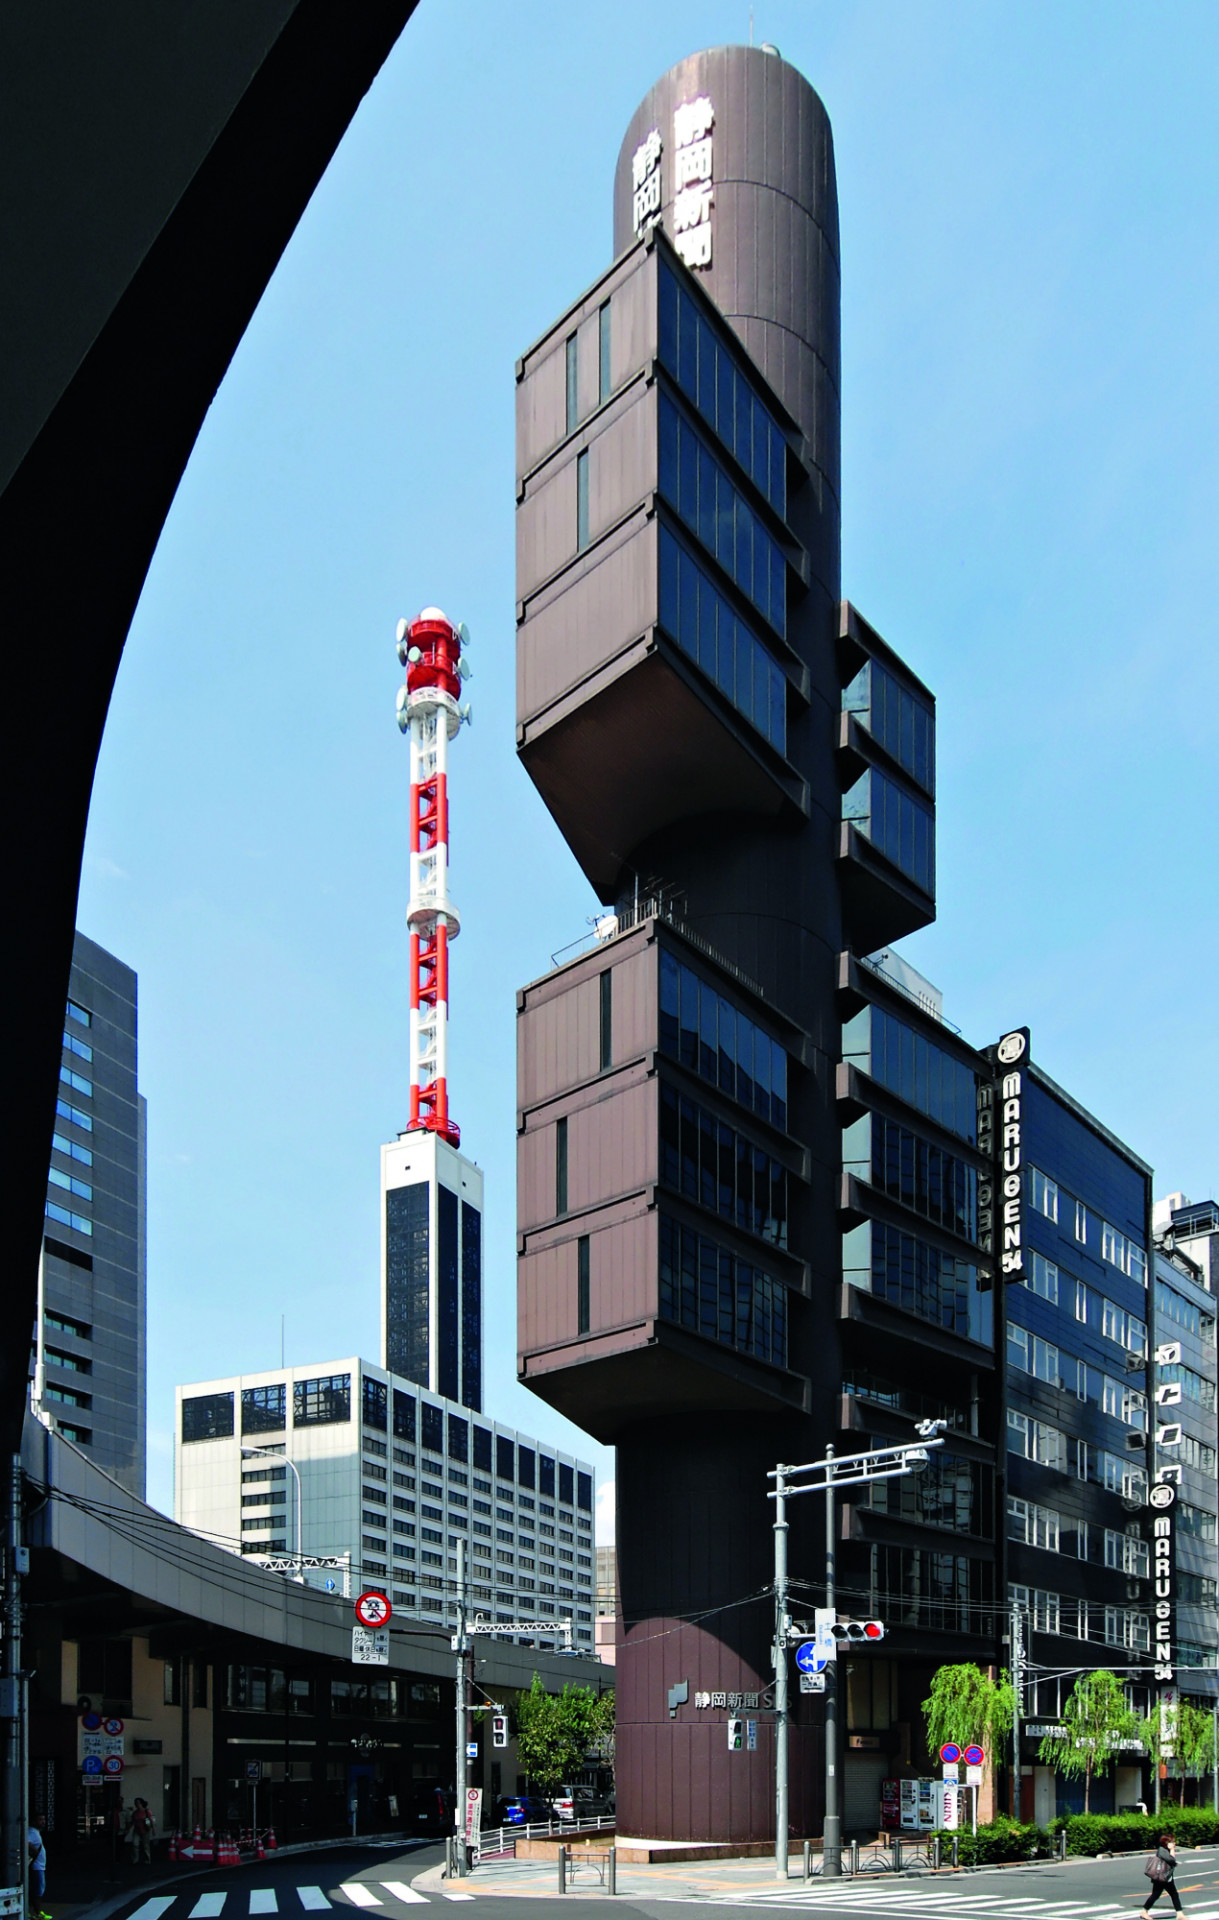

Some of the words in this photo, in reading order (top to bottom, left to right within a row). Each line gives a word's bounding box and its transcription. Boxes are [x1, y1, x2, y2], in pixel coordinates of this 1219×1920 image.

[632, 128, 663, 239] 静岡
[1002, 1071, 1022, 1249] MARUGEN
[1002, 1250, 1023, 1274] 54
[1154, 1516, 1172, 1662] MARUGEN
[1153, 1663, 1174, 1681] 54
[694, 1691, 759, 1709] 静岡新聞
[108, 1760, 120, 1770] 30
